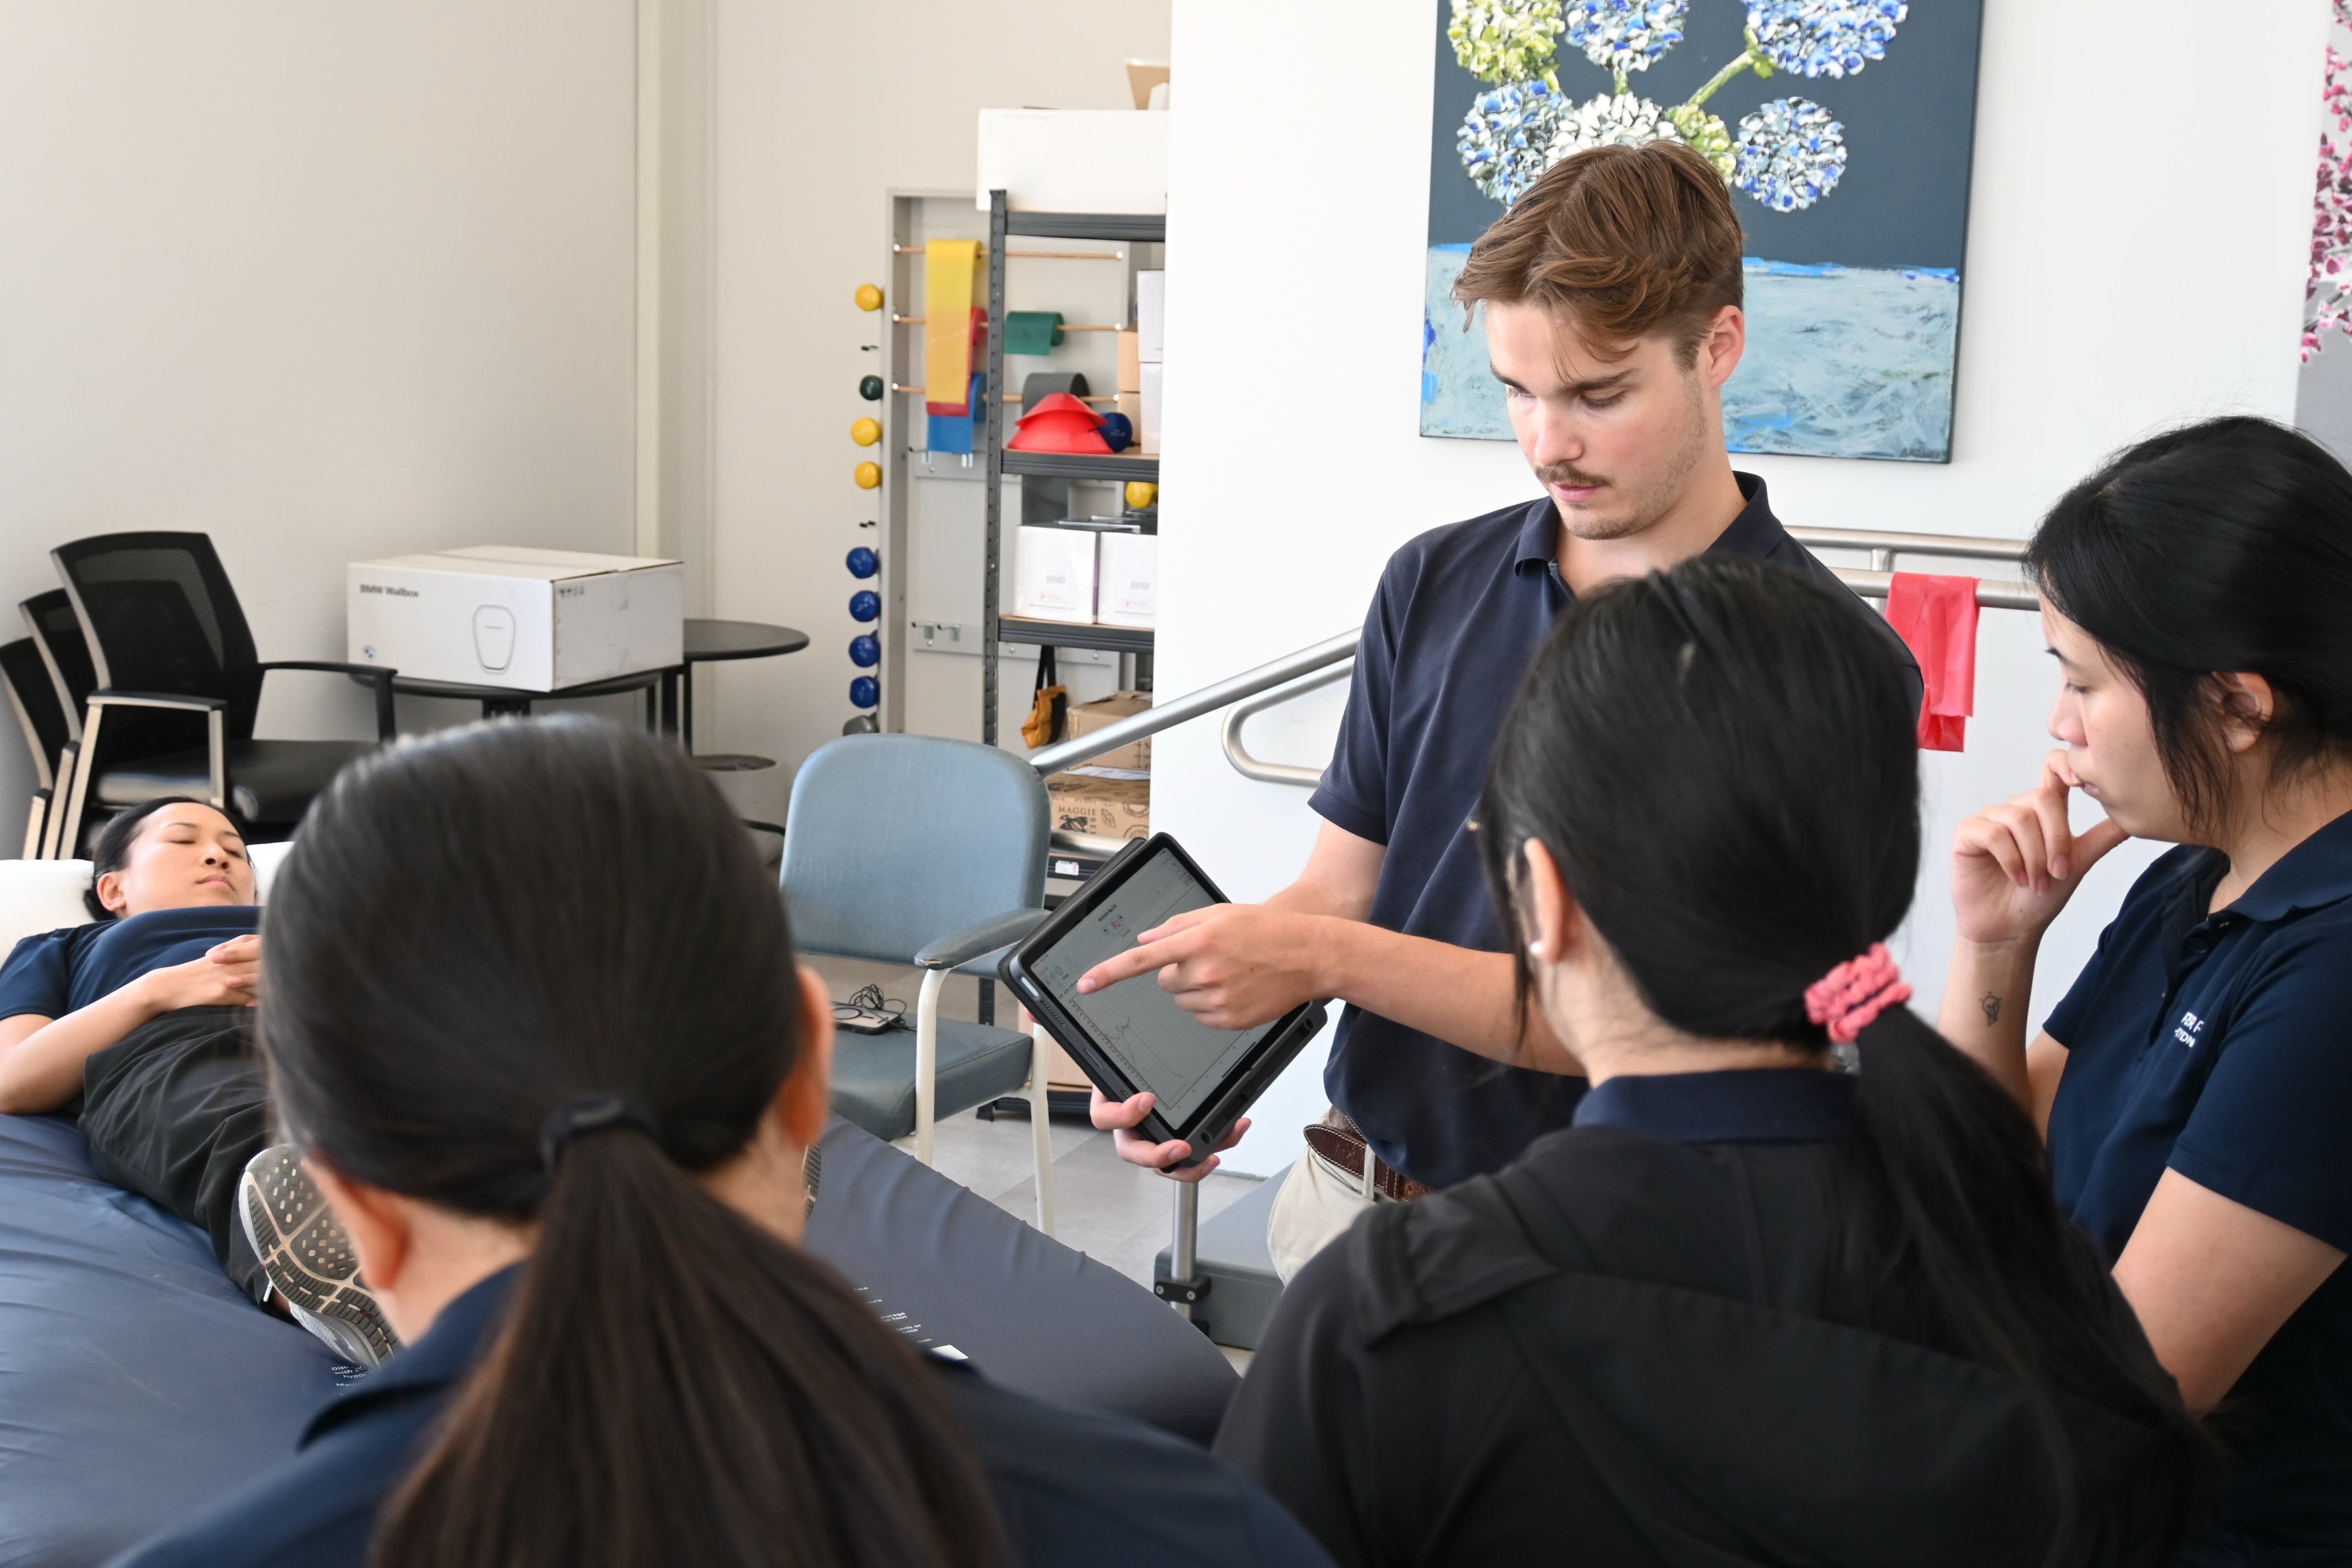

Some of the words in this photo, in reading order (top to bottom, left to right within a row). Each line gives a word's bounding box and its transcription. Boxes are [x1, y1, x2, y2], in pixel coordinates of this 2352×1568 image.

[360, 584, 382, 593] BMW
[386, 586, 419, 597] Wallbox
[1058, 806, 1096, 816] MAGGIE
